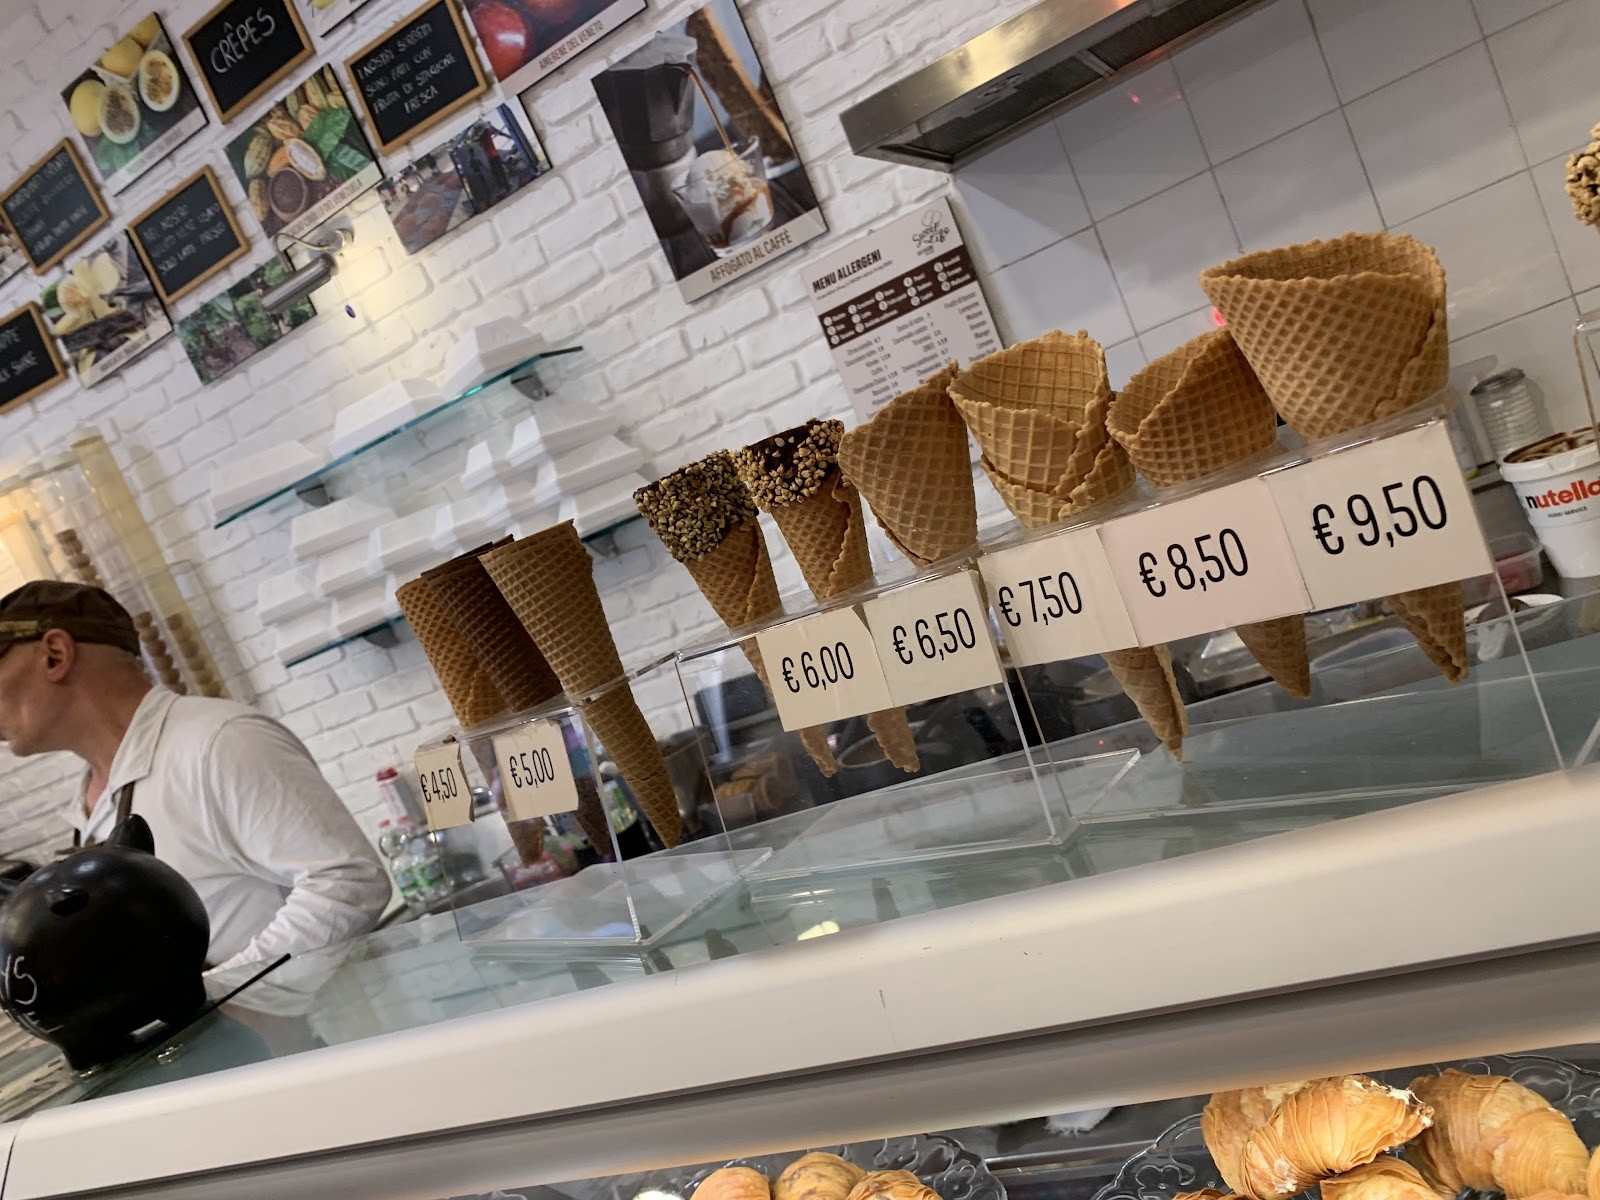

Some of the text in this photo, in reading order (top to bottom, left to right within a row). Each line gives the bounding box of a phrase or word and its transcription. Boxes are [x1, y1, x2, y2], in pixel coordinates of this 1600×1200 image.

[211, 6, 276, 74] CRÊPES
[413, 46, 432, 64] CON
[404, 85, 438, 114] FRESCA
[710, 228, 793, 283] AFFOGATO AL CAFFÈ
[812, 271, 837, 293] MENU
[837, 248, 882, 280] ALLERGENI
